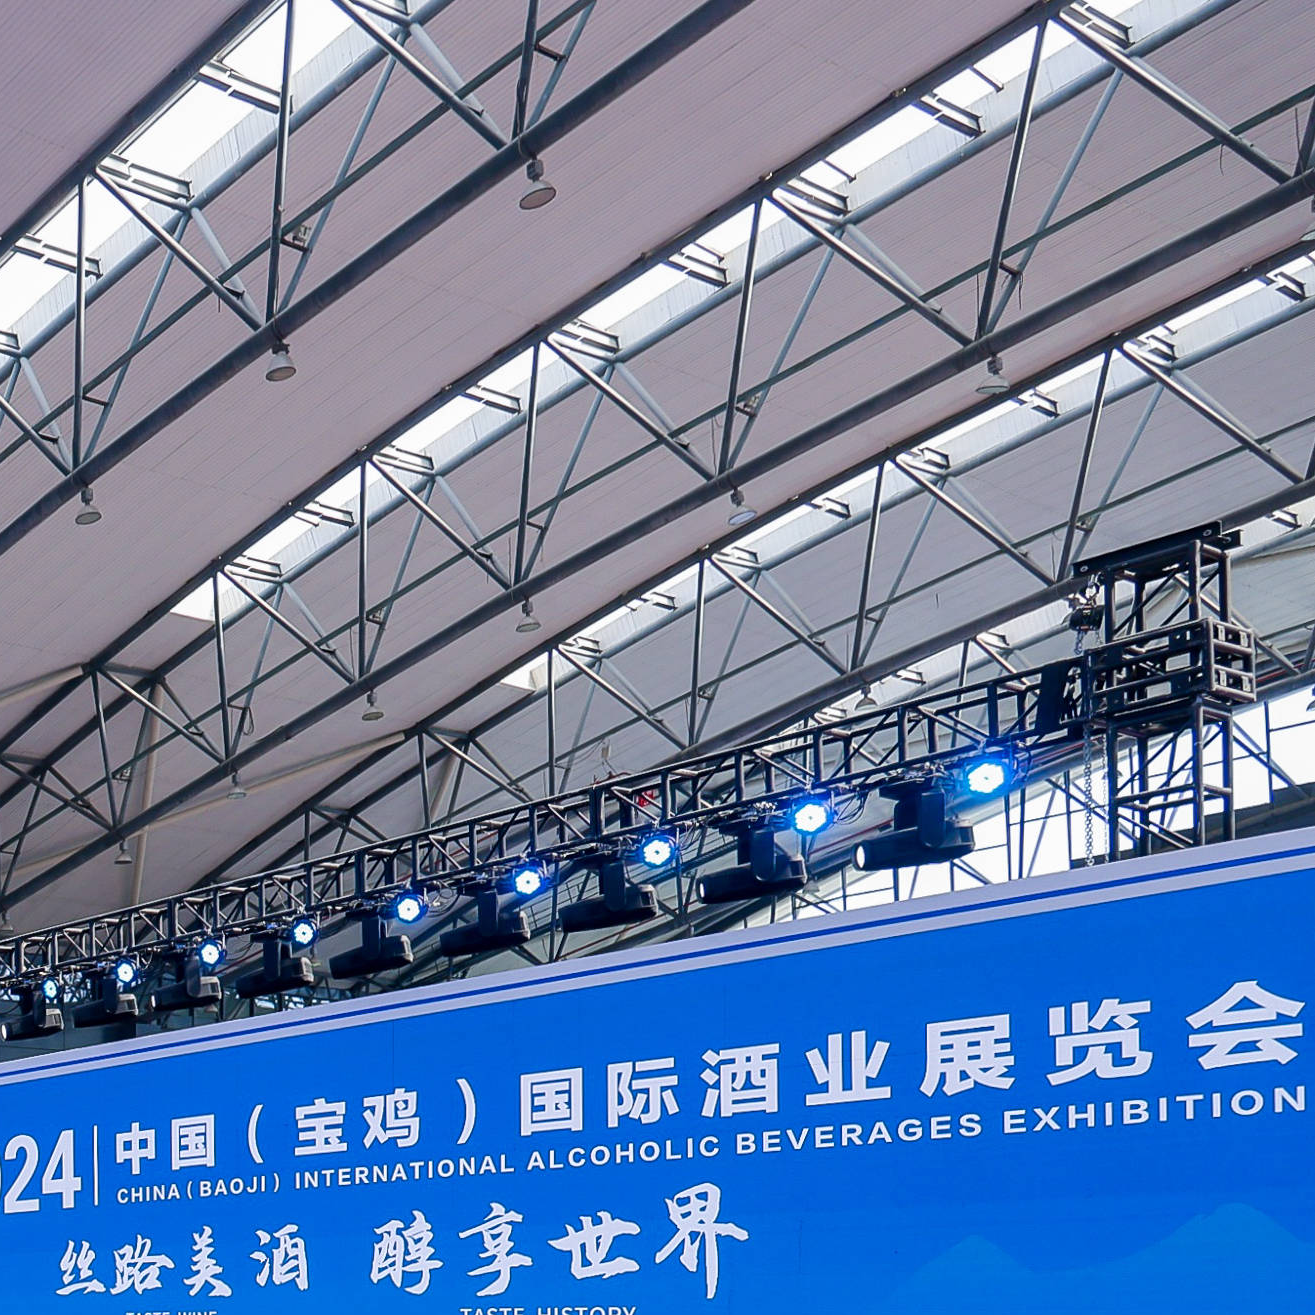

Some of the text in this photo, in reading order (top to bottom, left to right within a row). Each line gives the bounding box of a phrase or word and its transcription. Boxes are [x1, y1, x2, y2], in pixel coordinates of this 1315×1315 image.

[115, 980, 1306, 1175] 中国（宝鸡）国际酒业展览会
[116, 1183, 181, 1204] CHINA
[295, 1155, 515, 1190] INTERNATIONAL
[526, 1134, 720, 1171] ALCOHOLIC
[736, 1113, 983, 1156] BEVERAGES
[1002, 1085, 1308, 1134] EXHIBITION
[55, 1182, 750, 1300] 丝路美酒 醇享世界
